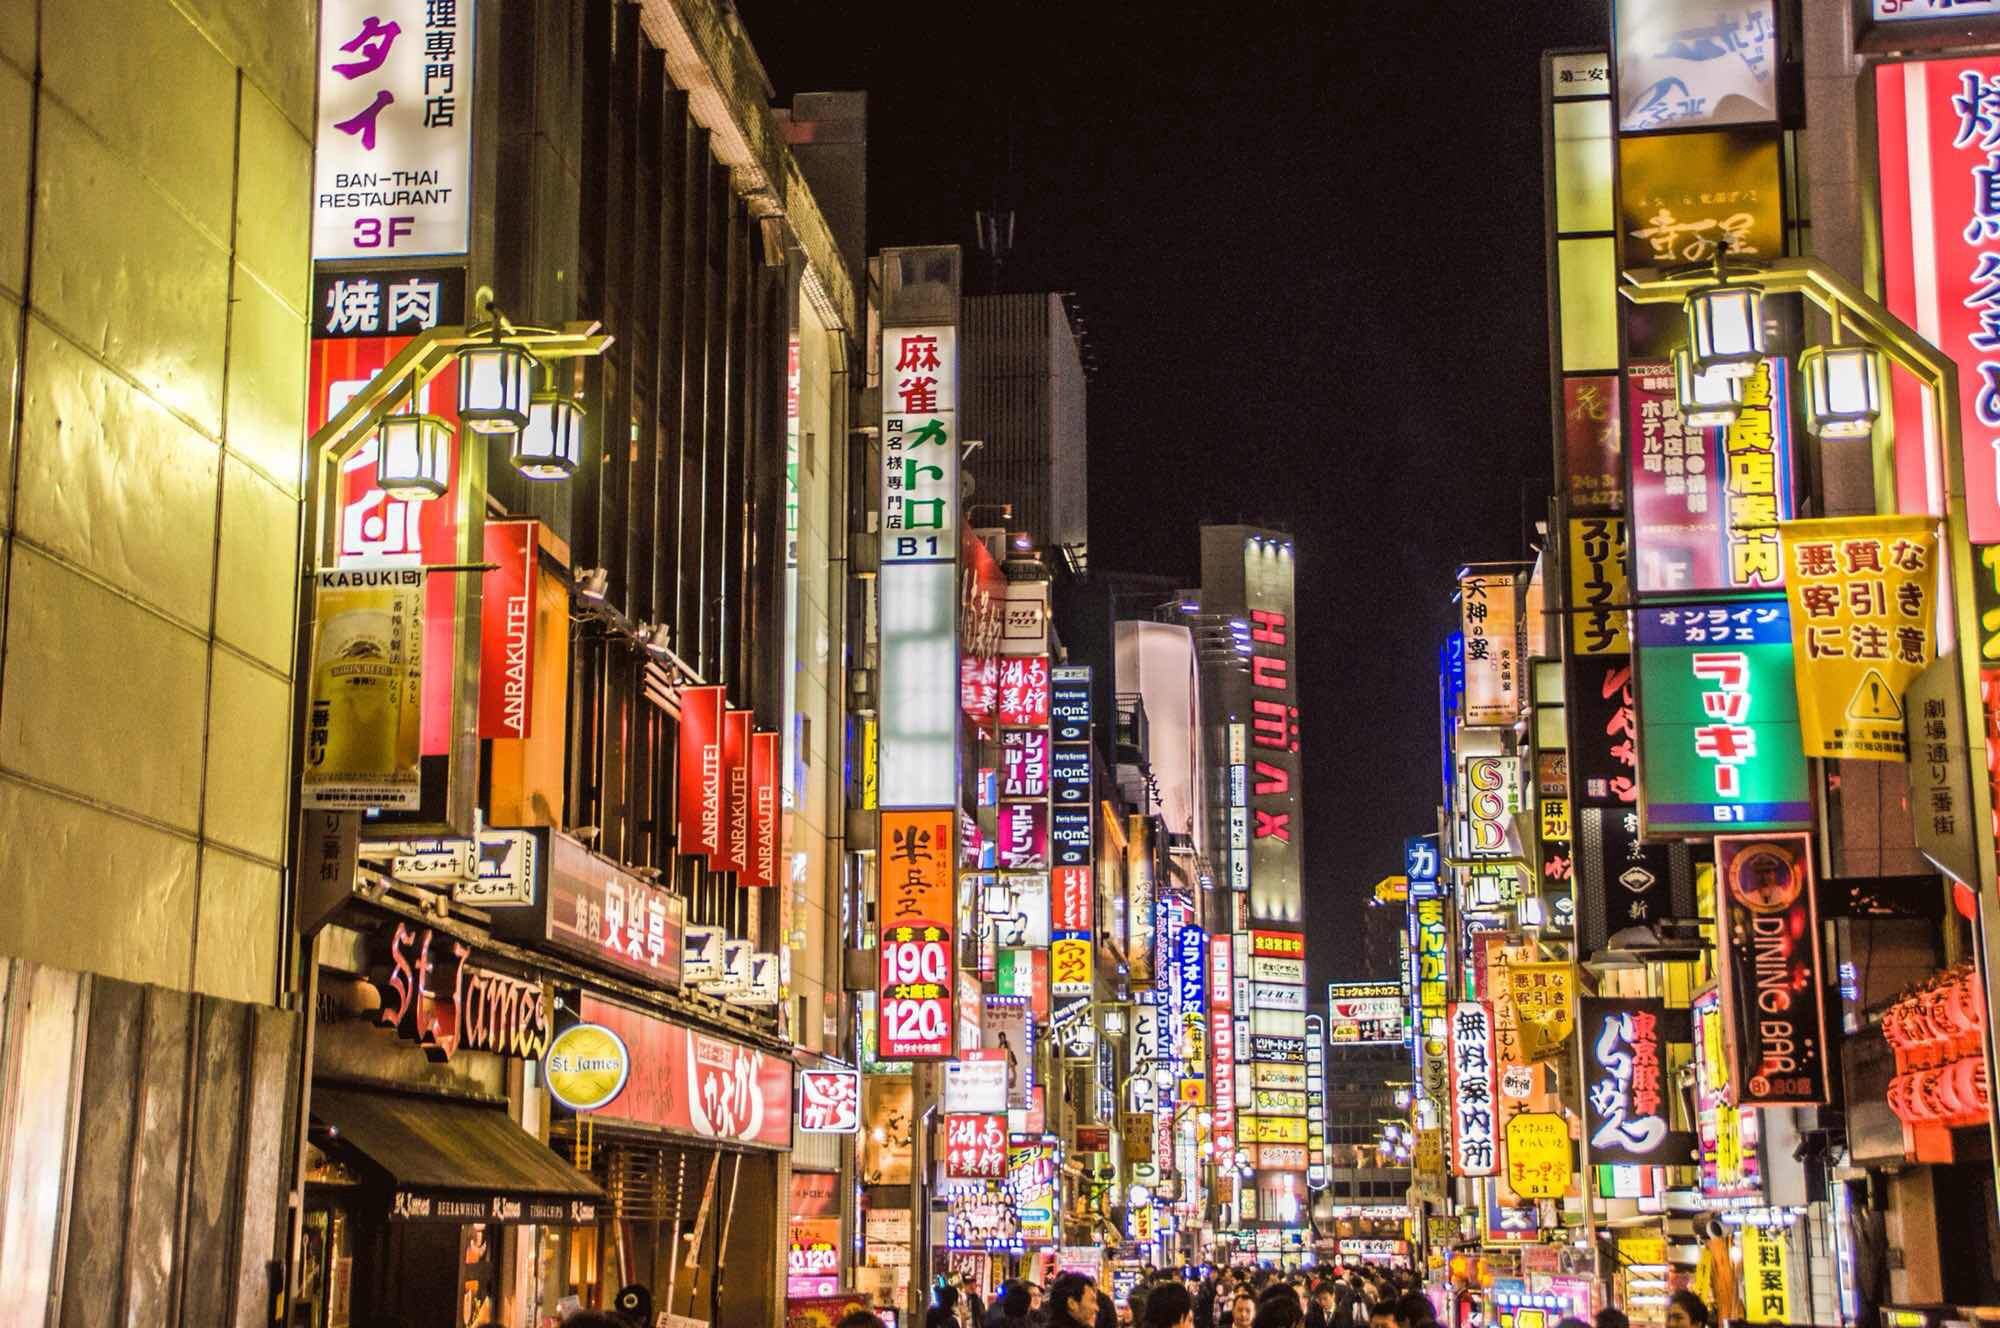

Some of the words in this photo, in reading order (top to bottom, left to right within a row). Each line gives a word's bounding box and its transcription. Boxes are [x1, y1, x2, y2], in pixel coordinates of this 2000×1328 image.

[331, 16, 402, 151] タイ
[1560, 68, 1611, 83] 第二安
[319, 189, 452, 208] RESTAURANT
[336, 170, 438, 188] BAN-THAI
[353, 217, 415, 248] 3F
[325, 278, 439, 333] 焼肉
[896, 335, 941, 414] 麻雀
[886, 419, 903, 529] 四名様専門店
[897, 536, 938, 556] B1
[1796, 540, 1926, 577] 悪質な
[1467, 577, 1489, 660] 天神の宴
[1659, 608, 1779, 626] オンライン
[1801, 580, 1926, 620] 客引き
[1685, 626, 1754, 642] カフェ
[1804, 624, 1928, 666] に注意
[502, 596, 528, 731] ANRAKUTEI
[1693, 652, 1757, 797] ラッキー
[1005, 749, 1023, 795] ルーム
[1025, 732, 1043, 795] レンタル
[1923, 698, 1954, 835] 劇場通り一番街
[702, 744, 721, 848] ANRAKUTEI
[730, 766, 748, 865] ANRAKUTEI
[1471, 758, 1506, 850] GOD
[1714, 806, 1745, 821] B1
[756, 785, 774, 882] ANRAKUTEI
[1012, 805, 1032, 853] エデン
[394, 859, 461, 873] 黒毛和牛
[456, 882, 518, 896] 黒毛和牛
[604, 878, 666, 968] 安楽亭
[1753, 915, 1791, 1015] DINING
[1760, 1020, 1795, 1078] BAR
[1456, 1010, 1492, 1167] 無料案内所
[950, 1118, 1003, 1148] 湖南
